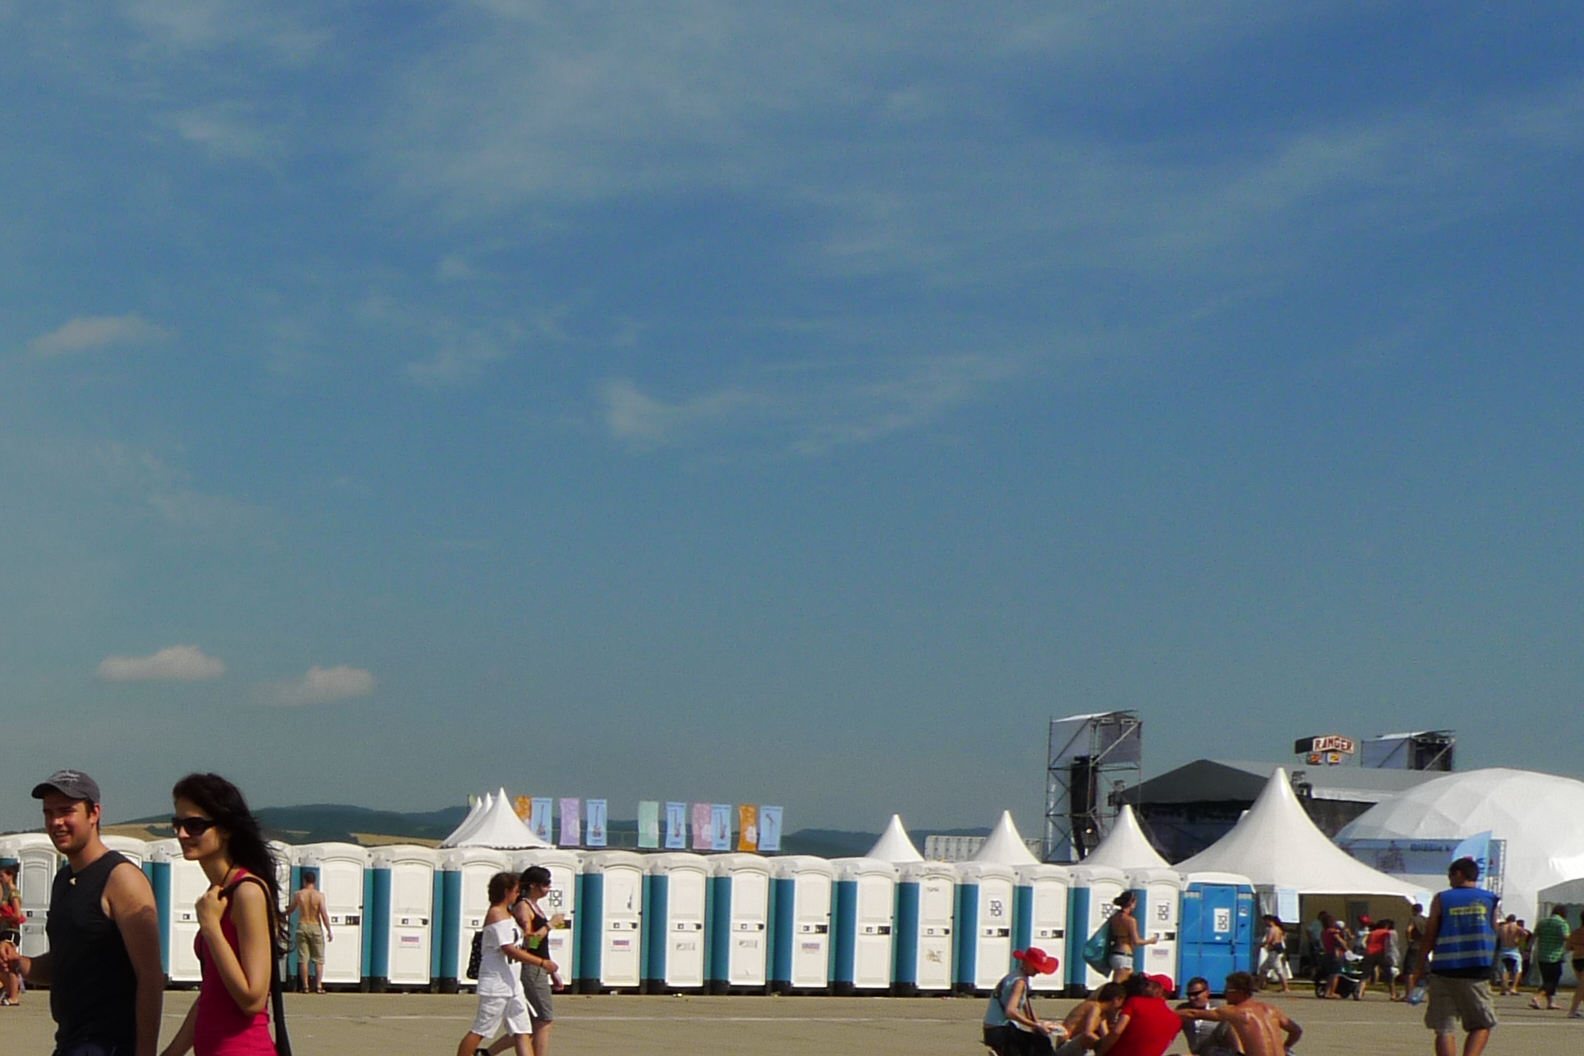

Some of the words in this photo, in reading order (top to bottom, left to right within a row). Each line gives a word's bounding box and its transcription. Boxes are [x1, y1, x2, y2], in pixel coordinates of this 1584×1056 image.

[1315, 737, 1353, 751] RANGER
[548, 889, 563, 899] TOI
[548, 898, 563, 907] TOI
